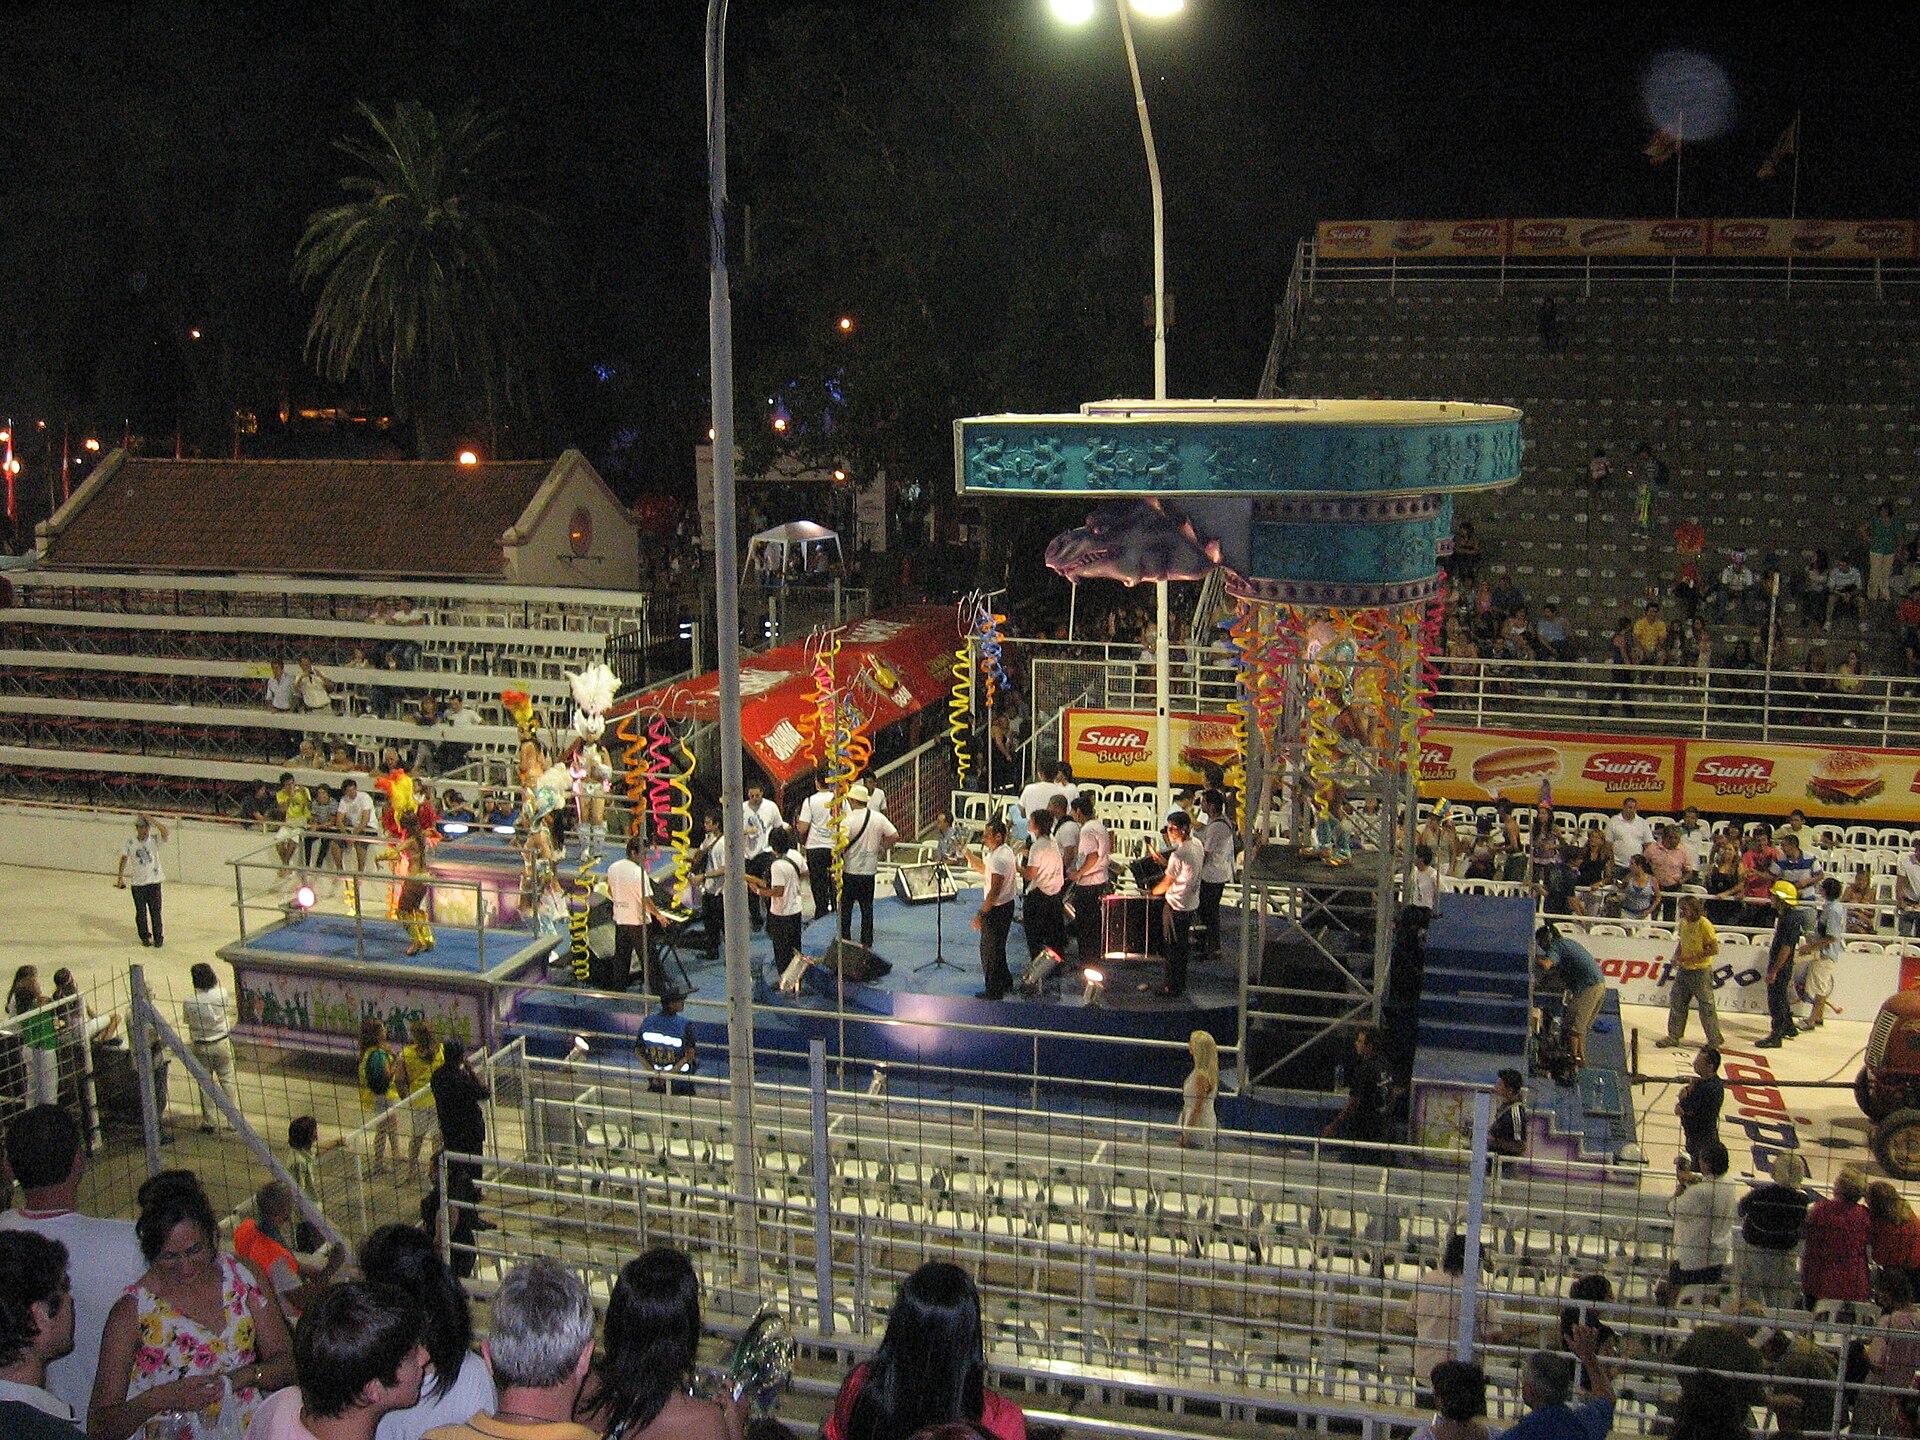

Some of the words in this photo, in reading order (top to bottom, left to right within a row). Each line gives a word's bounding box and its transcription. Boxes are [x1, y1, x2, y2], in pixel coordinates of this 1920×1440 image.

[1079, 731, 1146, 748] Swift
[1097, 750, 1152, 766] Burger
[1583, 758, 1657, 776] Swift
[1694, 762, 1769, 779] Swift
[1605, 777, 1664, 792] Salchichas
[1715, 781, 1777, 798] Burger
